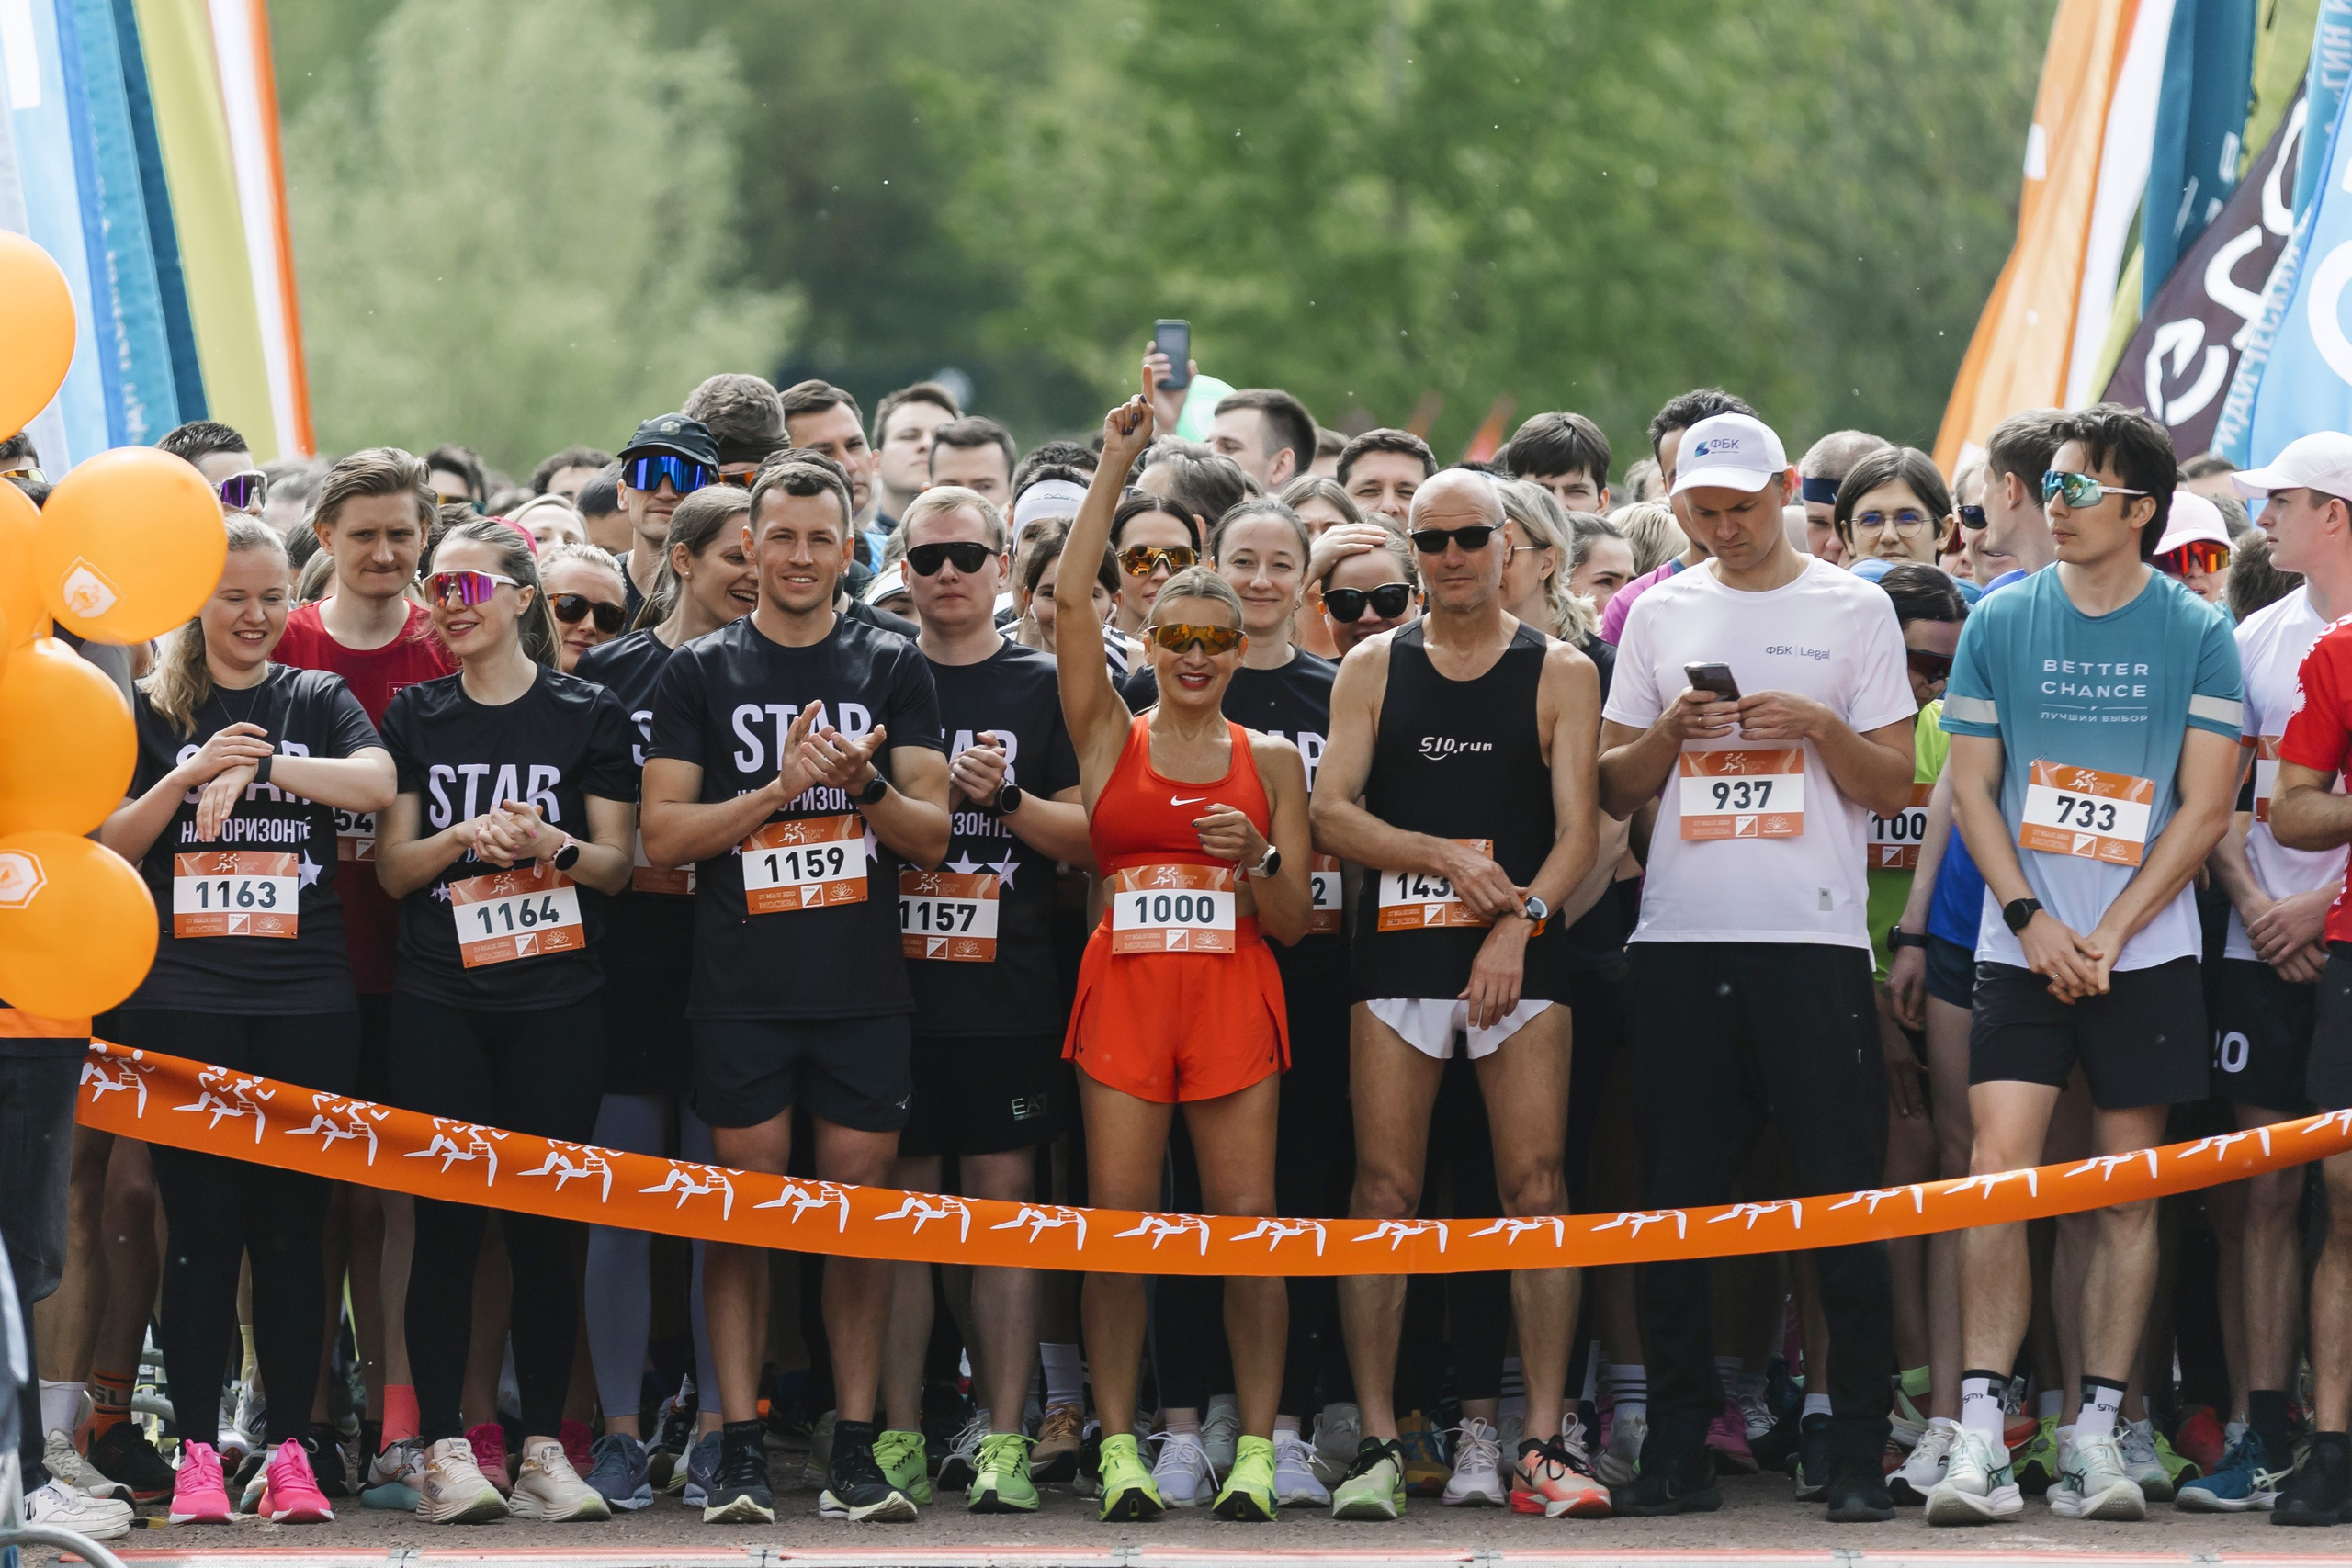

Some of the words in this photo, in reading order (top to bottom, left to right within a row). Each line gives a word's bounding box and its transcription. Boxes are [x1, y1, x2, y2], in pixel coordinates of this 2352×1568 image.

[1710, 438, 1739, 449] ФБК
[1766, 645, 1792, 655] ФБК
[1801, 647, 1831, 660] Legal
[2043, 659, 2149, 676] BETTER
[2041, 681, 2148, 698] CHANCE
[2102, 714, 2149, 723] ВЫБОР
[428, 763, 561, 829] STAR
[1712, 780, 1773, 810] 937
[2056, 795, 2117, 831] 733
[764, 847, 844, 883] 1159
[196, 880, 277, 908] 1163
[1396, 872, 1461, 900] 143
[477, 895, 560, 934] 1164
[899, 900, 978, 932] 1157
[1135, 895, 1215, 924] 1000
